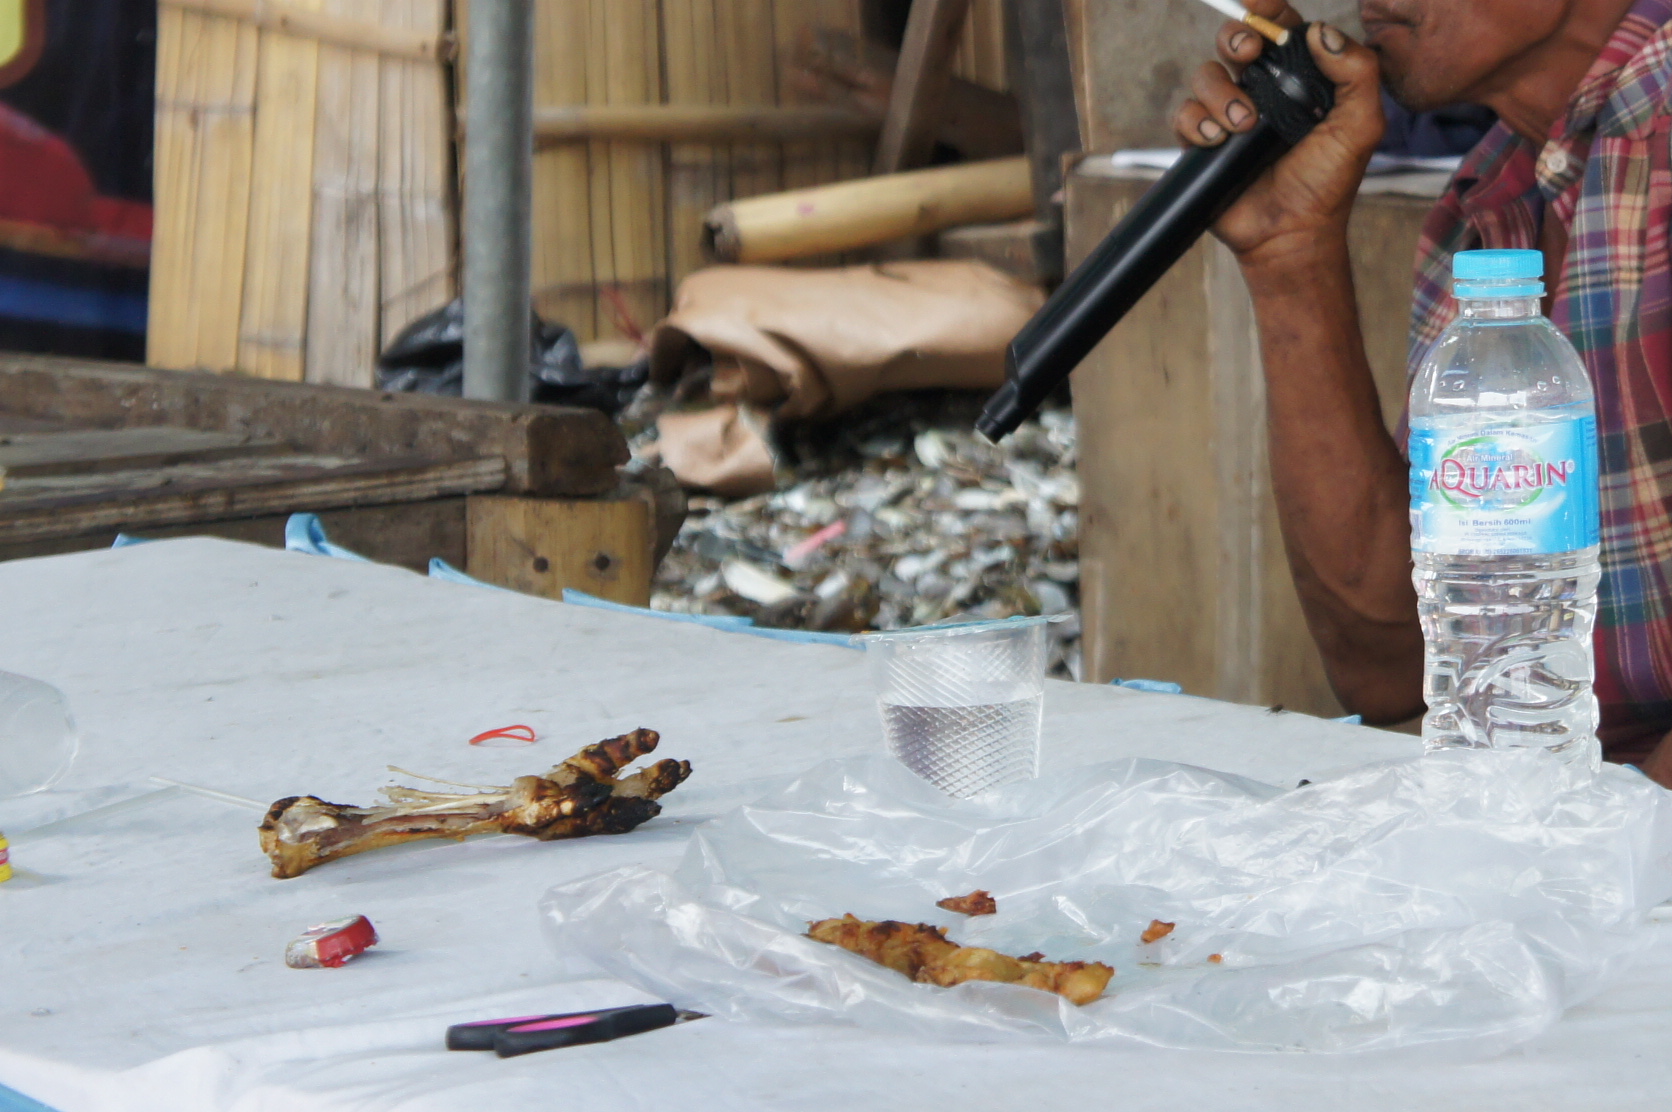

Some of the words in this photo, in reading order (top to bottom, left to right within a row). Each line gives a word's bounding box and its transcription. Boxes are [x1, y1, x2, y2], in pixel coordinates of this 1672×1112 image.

[1480, 429, 1504, 437] Dalam
[1466, 454, 1478, 463] Air
[1480, 453, 1513, 463] Mineral
[1429, 458, 1568, 498] AQUARIN
[1472, 518, 1502, 527] Bersih
[1503, 518, 1531, 526] 600ml
